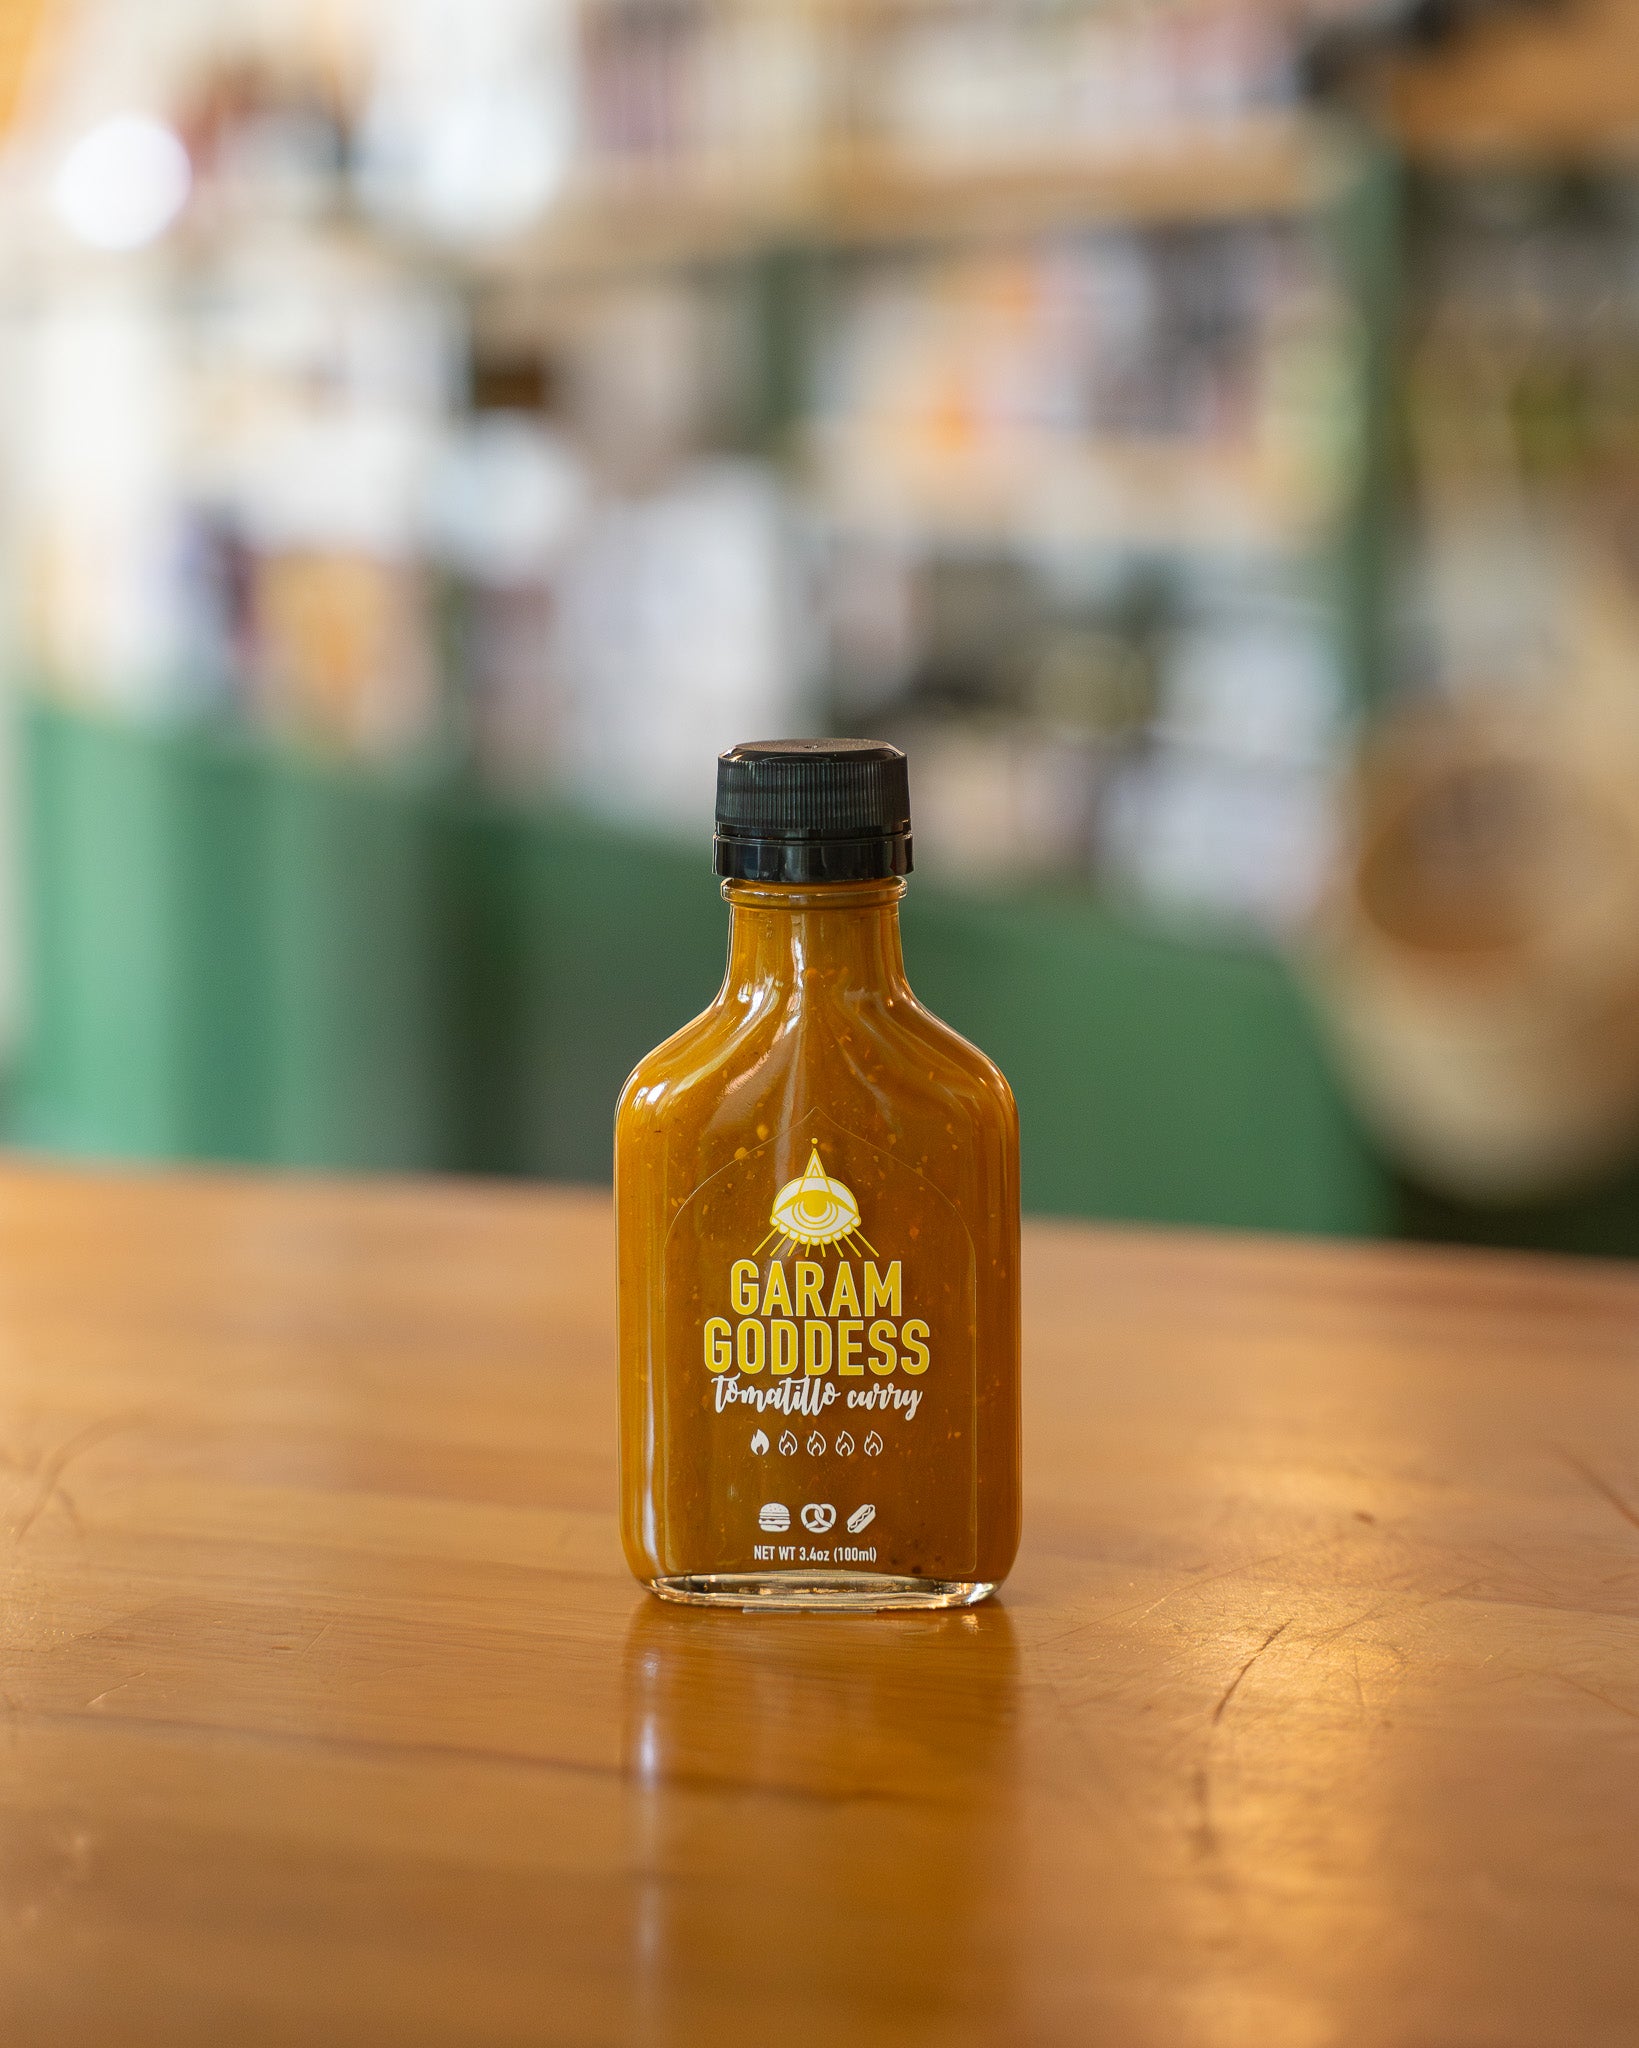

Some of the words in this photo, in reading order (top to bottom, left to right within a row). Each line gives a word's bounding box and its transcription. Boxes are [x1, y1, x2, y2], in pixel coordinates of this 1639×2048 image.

[730, 1259, 902, 1317] GARAM
[703, 1316, 931, 1376] GODDESS
[711, 1372, 841, 1416] tomatillo
[847, 1382, 923, 1421] curry
[753, 1545, 775, 1561] NET
[778, 1546, 796, 1561] WT
[799, 1546, 830, 1561] 3.4oz
[833, 1546, 877, 1563] (100ml)
